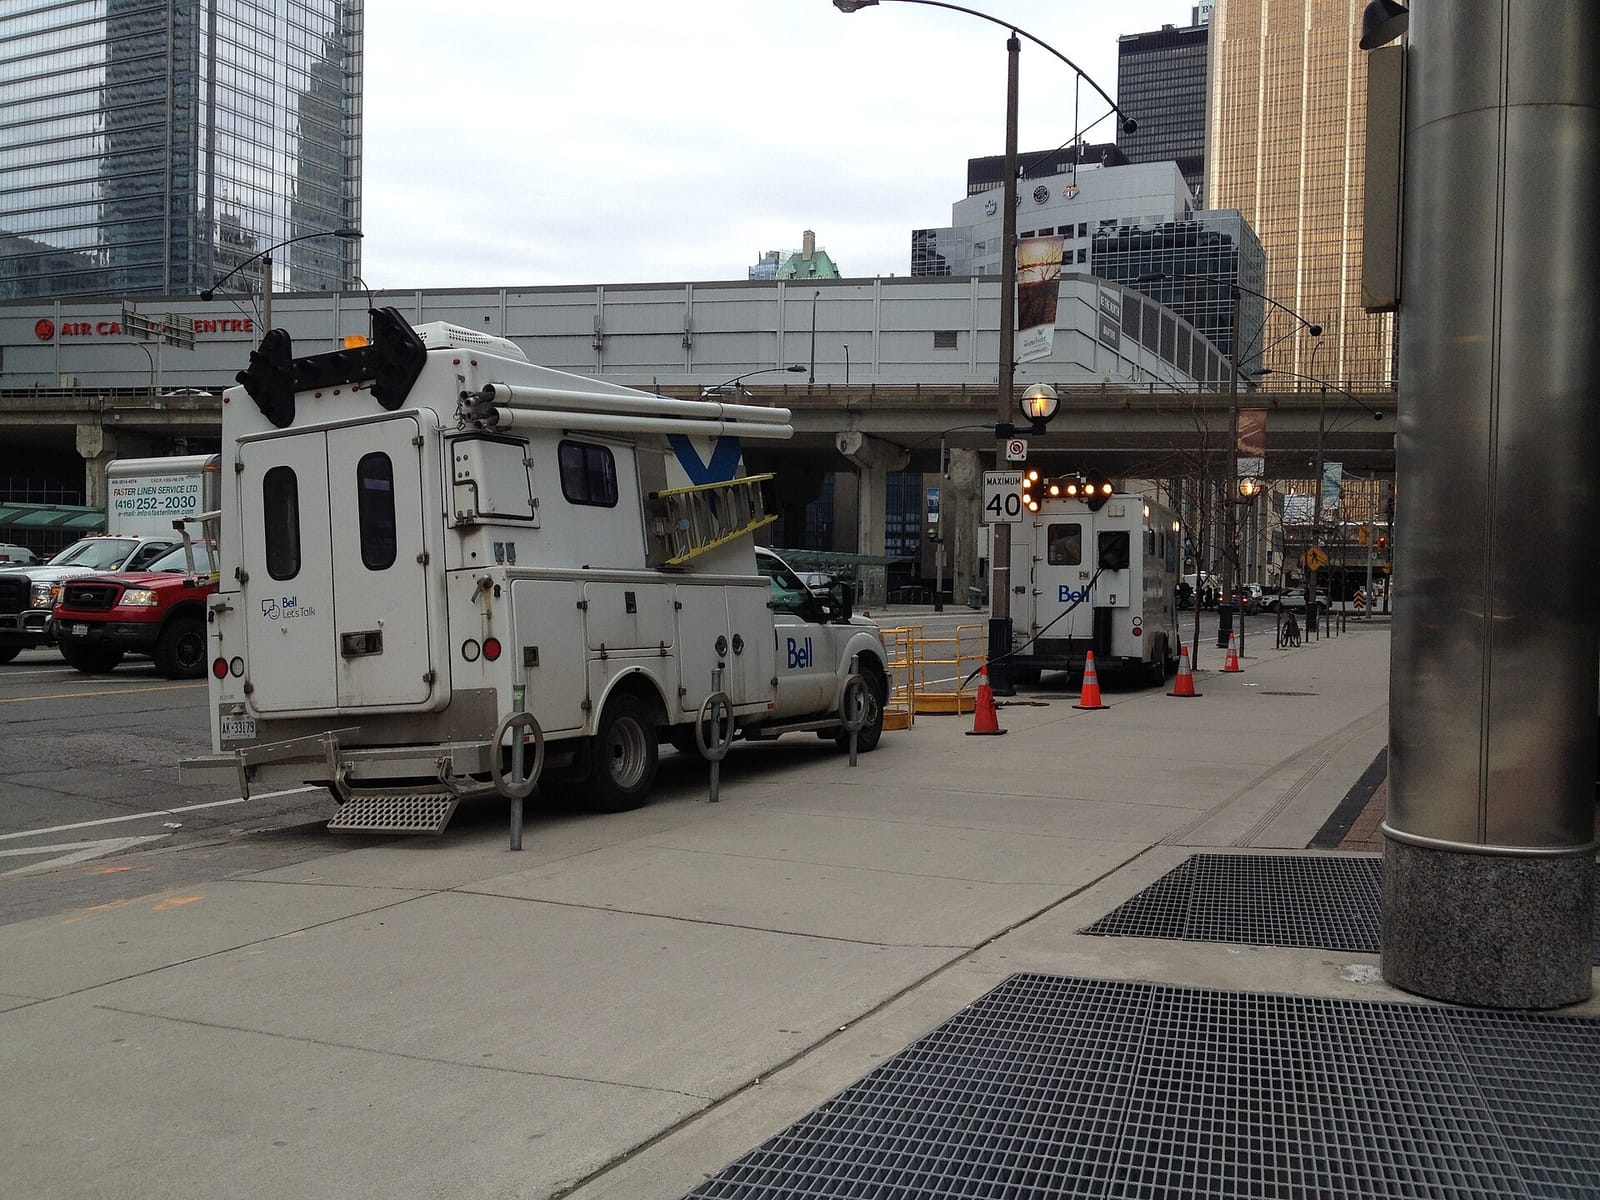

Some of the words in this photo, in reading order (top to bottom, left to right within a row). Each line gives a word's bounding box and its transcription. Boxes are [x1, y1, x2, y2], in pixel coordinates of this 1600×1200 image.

[61, 322, 92, 336] AIR
[193, 319, 253, 333] ENTRE
[986, 477, 1021, 486] MAXIMUM
[113, 487, 136, 497] FASTER
[137, 486, 157, 496] LINEN
[158, 484, 185, 495] SERVICE
[186, 484, 198, 493] LTD
[115, 499, 136, 510] (416)
[136, 495, 196, 510] 252-2030
[985, 493, 1021, 517] 40
[1058, 584, 1090, 603] Bell
[282, 596, 297, 608] Bell
[282, 607, 300, 619] Let's
[300, 606, 316, 617] Talk
[786, 636, 813, 669] Bell
